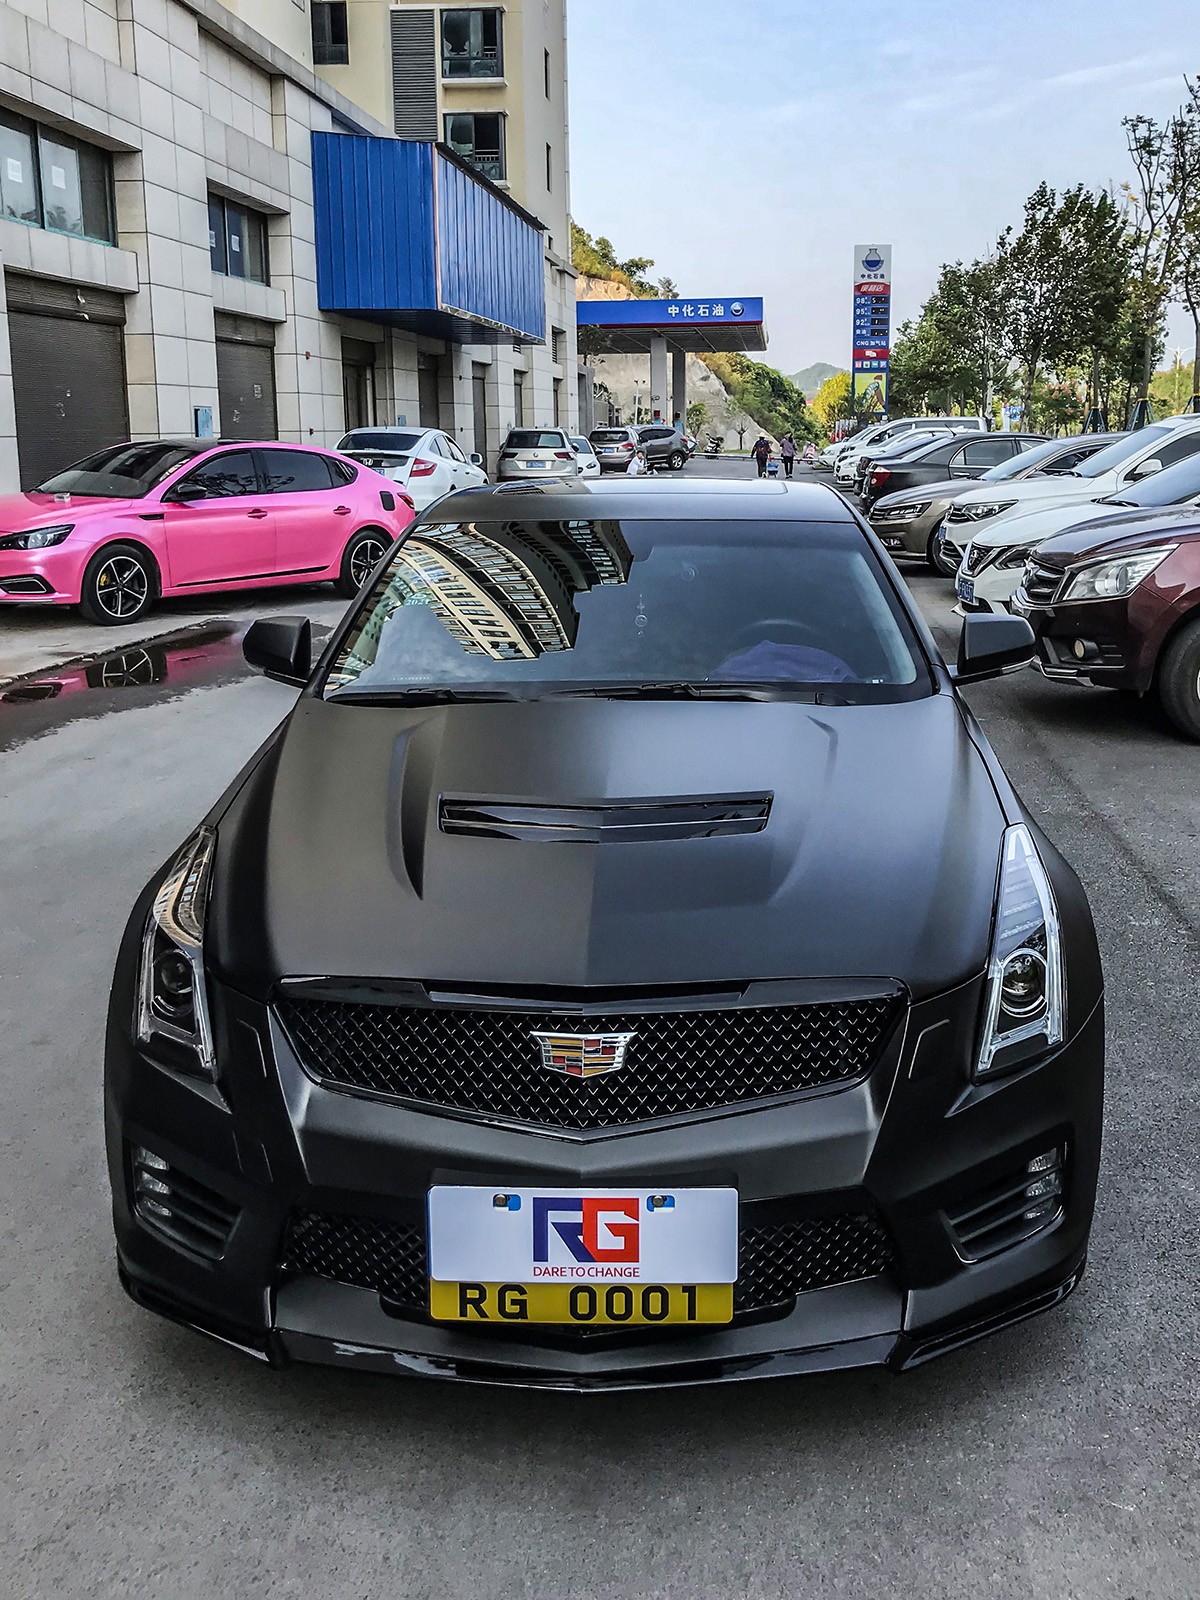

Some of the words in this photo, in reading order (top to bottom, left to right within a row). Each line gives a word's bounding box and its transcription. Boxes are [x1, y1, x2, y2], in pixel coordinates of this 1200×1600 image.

[668, 304, 724, 317] 中化石油
[533, 1197, 639, 1263] RG
[533, 1266, 567, 1277] DARE
[568, 1266, 585, 1277] TO
[587, 1267, 640, 1278] CHANGE
[458, 1282, 529, 1320] RG
[569, 1284, 697, 1321] 0001
